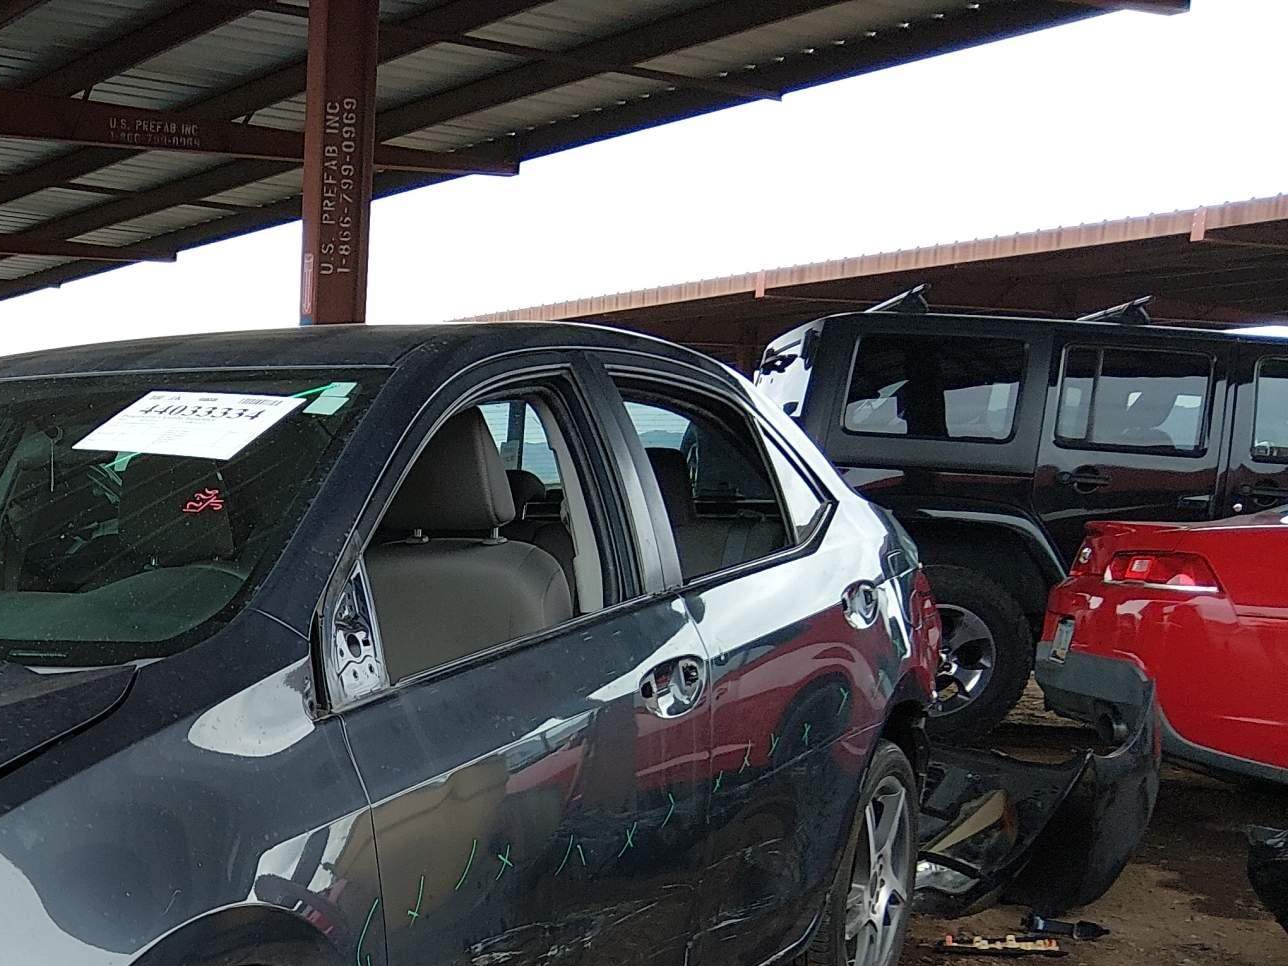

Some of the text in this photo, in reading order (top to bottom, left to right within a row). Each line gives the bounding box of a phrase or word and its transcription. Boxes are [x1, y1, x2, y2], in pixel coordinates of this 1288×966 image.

[135, 119, 177, 134] PREFAB
[322, 145, 340, 225] PREFAB
[336, 98, 358, 274] 1-866-799-0969
[139, 403, 266, 421] 44033334
